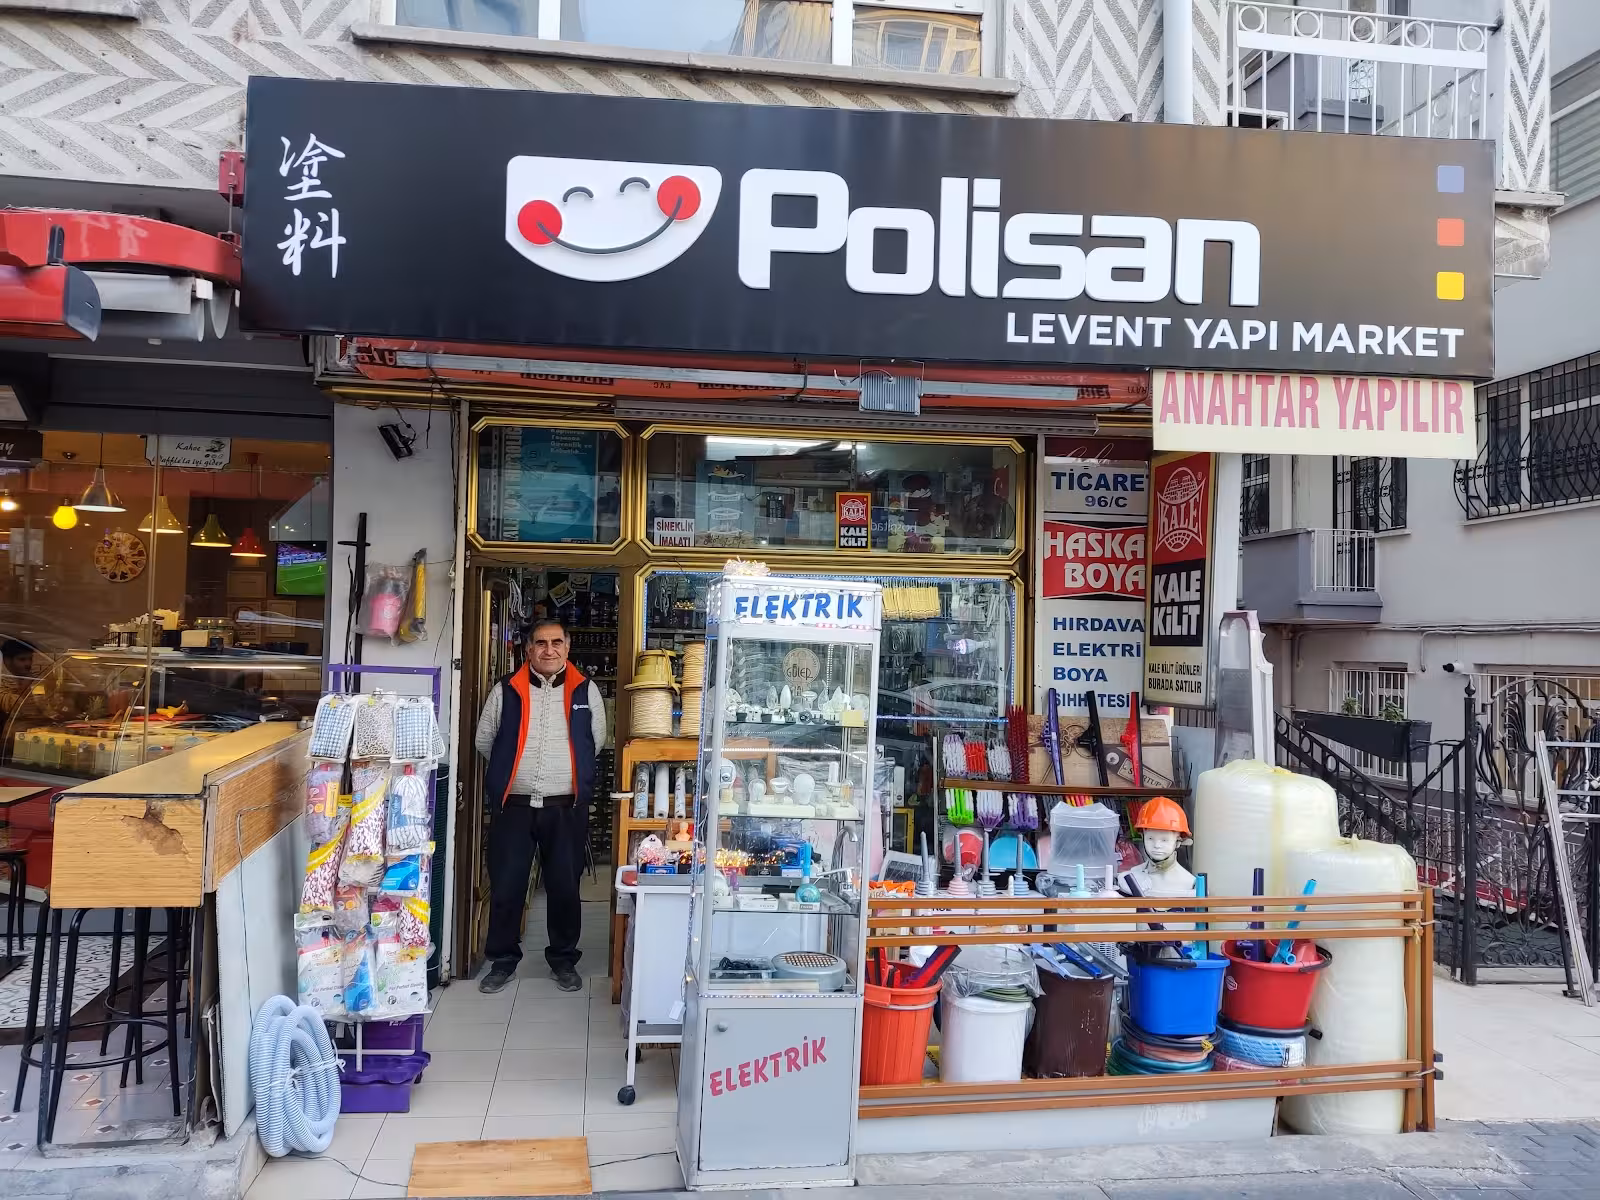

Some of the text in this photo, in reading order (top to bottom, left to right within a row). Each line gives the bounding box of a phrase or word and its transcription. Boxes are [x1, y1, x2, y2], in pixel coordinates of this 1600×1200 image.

[277, 133, 347, 279] 塗料
[738, 168, 1260, 307] Polisan
[1006, 312, 1465, 358] LEVENT YAPI MARKET
[1159, 371, 1465, 434] ANAHTAR YAPILIR
[1050, 468, 1149, 492] TİCARE
[843, 507, 867, 521] KALE
[1084, 495, 1128, 508] 96/C
[656, 519, 694, 532] SİNEKLİK
[840, 526, 868, 536] KALE
[1159, 497, 1200, 542] KALE
[659, 534, 691, 546] İMALATI
[1044, 531, 1146, 561] HASKA
[1064, 562, 1146, 593] BOYA
[1154, 569, 1201, 604] KALE
[1053, 617, 1145, 633] HIRDAVA
[1152, 604, 1201, 636] KİLİT
[1053, 667, 1108, 682] BOYA
[1148, 662, 1161, 674] KALE
[1148, 677, 1202, 694] BURADA SATILIR
[709, 1035, 828, 1097] ELEKTRİK
